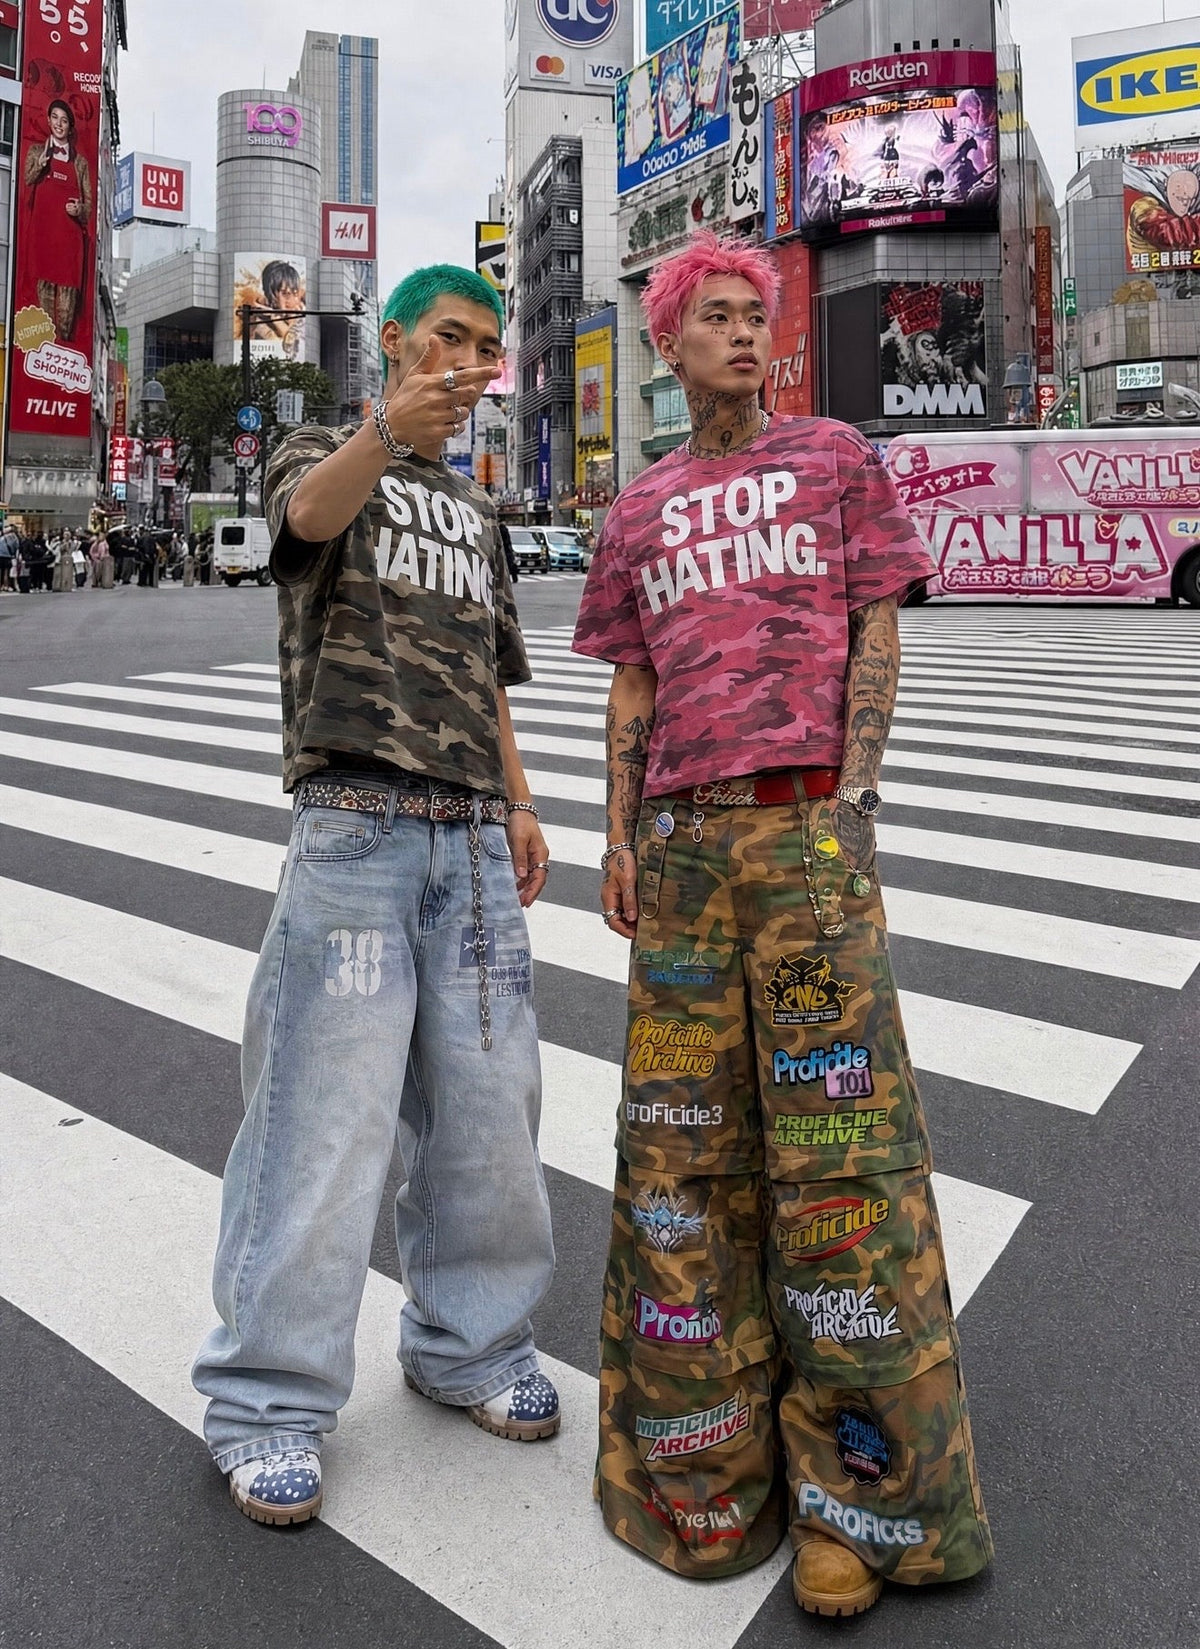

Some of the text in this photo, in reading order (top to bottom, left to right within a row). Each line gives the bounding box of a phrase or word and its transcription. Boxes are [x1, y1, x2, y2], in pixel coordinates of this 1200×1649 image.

[588, 64, 623, 79] VISA
[850, 61, 929, 88] Rakuten
[243, 101, 303, 147] 109
[247, 135, 289, 147] SHIBUYA
[147, 169, 177, 188] UNI
[147, 187, 178, 205] QLO
[33, 359, 88, 385] SHOPPING
[26, 398, 77, 418] 17LIVE
[883, 384, 985, 415] DMM
[380, 475, 482, 548] STOP
[661, 471, 797, 547] STOP
[909, 500, 1168, 580] VANILLA
[640, 523, 828, 615] HATING.
[325, 929, 384, 997] 38
[629, 1015, 714, 1050] Proficide
[632, 1042, 715, 1074] Archive
[836, 1070, 870, 1095] 101
[773, 1127, 868, 1146] ARCHIVE
[776, 1198, 889, 1252] Proficide
[651, 1410, 748, 1456] ARCHIVE
